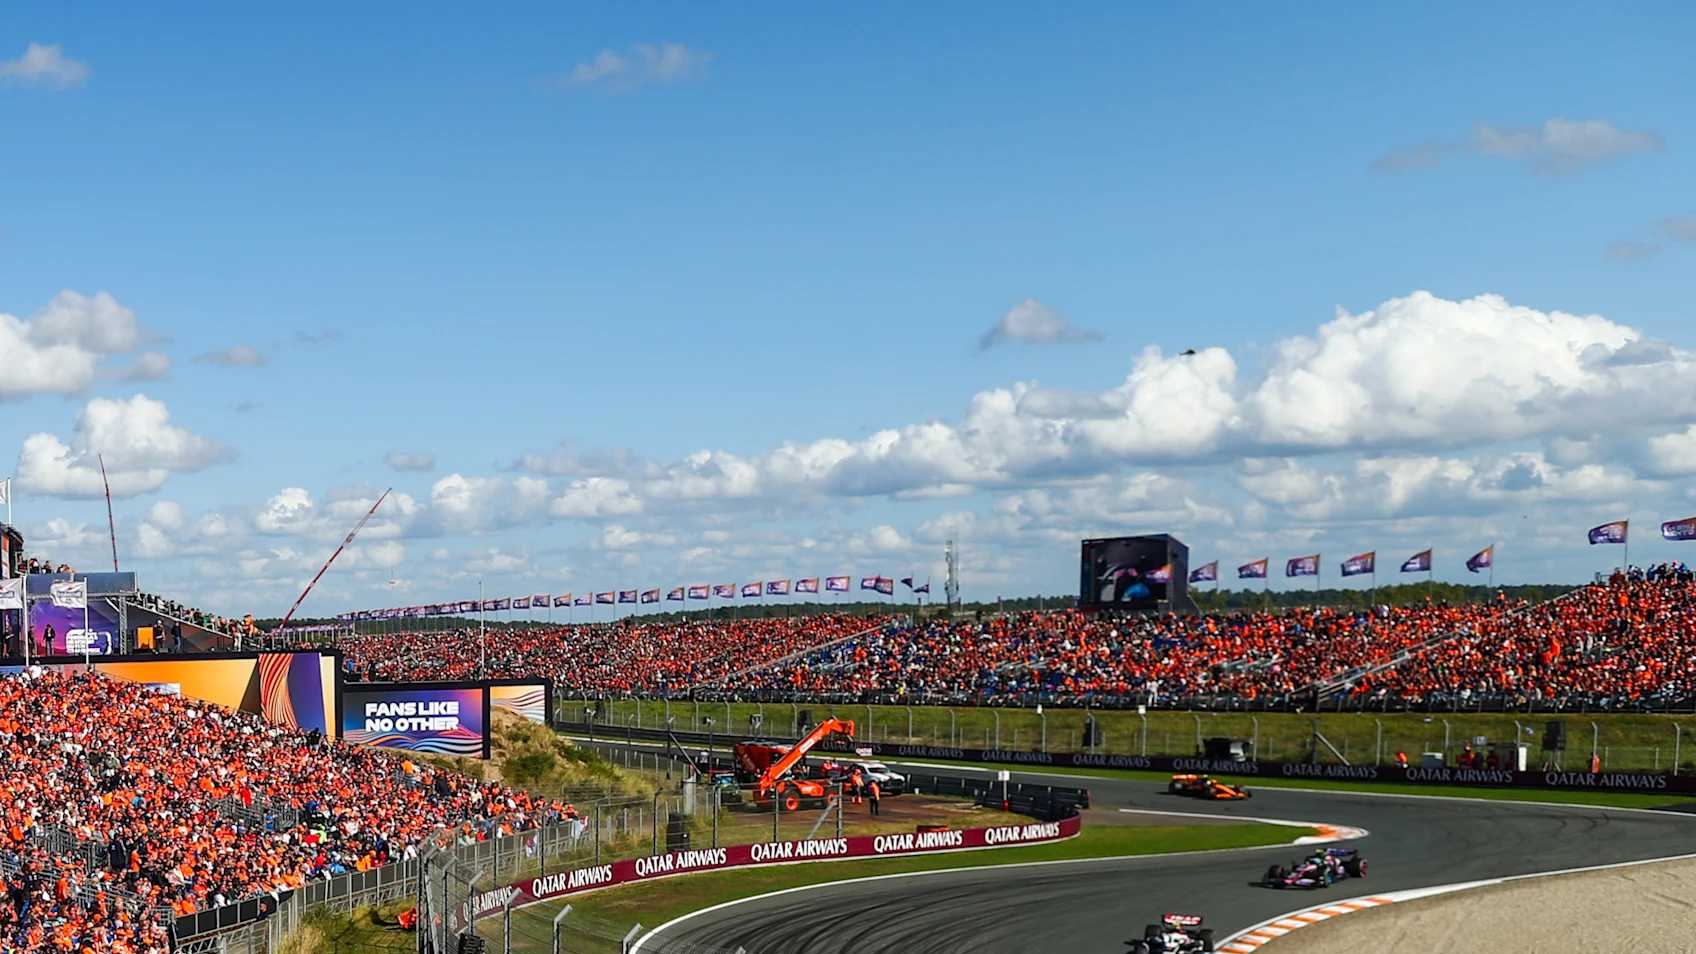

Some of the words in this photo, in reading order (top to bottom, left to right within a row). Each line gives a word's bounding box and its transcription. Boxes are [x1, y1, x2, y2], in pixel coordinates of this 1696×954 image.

[365, 702, 416, 717] FANS
[418, 701, 459, 715] LIKE
[365, 718, 393, 732] NO
[395, 717, 459, 731] OTHER
[899, 745, 929, 756] QATAR
[931, 747, 964, 759] AIRWAYS
[982, 750, 1015, 761] QATAR
[1017, 752, 1053, 763] AIRWAYS
[1073, 754, 1111, 765] QATAR
[1112, 756, 1151, 768] AIRWAYS
[1173, 758, 1210, 771] QATAR
[1211, 760, 1258, 772] AIRWAYS
[1283, 763, 1321, 776] QATAR
[1323, 765, 1378, 778] AIRWAYS
[1406, 768, 1451, 781] QATAR
[1453, 769, 1513, 783] AIRWAYS
[1546, 772, 1596, 786] QATAR
[1599, 774, 1666, 788] AIRWAYS
[985, 827, 1019, 844] QATAR
[1021, 821, 1060, 839] AIRWAYS
[874, 834, 913, 853] QATAR
[916, 830, 962, 848] AIRWAYS
[751, 841, 793, 861] QATAR
[795, 838, 847, 858] AIRWAYS
[635, 856, 673, 876] QATAR
[676, 848, 726, 869] AIRWAYS
[532, 873, 566, 897] QATAR
[568, 864, 612, 890] AIRWAYS
